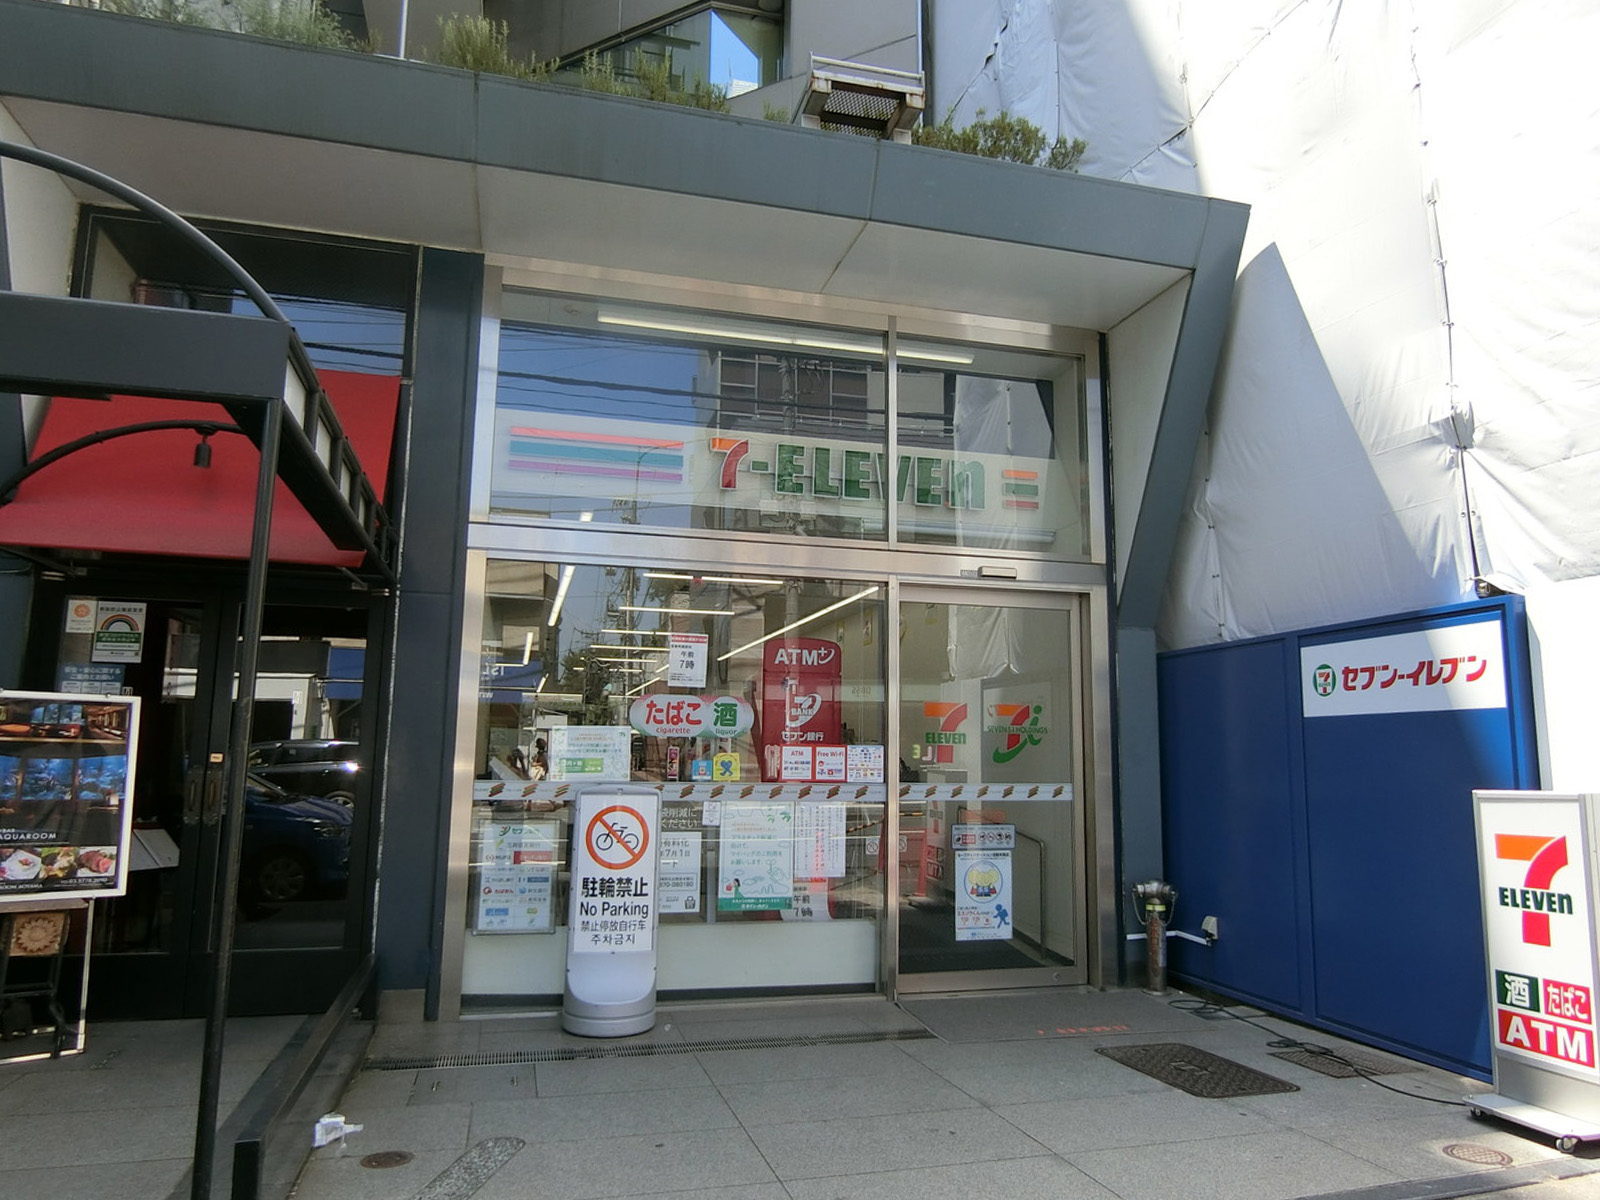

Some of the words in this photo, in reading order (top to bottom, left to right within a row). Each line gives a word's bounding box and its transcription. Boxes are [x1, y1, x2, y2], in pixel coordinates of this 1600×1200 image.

[645, 700, 703, 726] たばこ
[713, 702, 738, 727] 酒
[791, 707, 815, 717] BANK
[656, 727, 691, 735] cigarette
[715, 728, 738, 736] liquor
[781, 731, 824, 742] セブン銀行
[581, 877, 649, 898] 駐輪禁止
[580, 901, 598, 916] No
[602, 901, 649, 919] Parking
[581, 920, 647, 932] 禁止停放自行车
[591, 933, 636, 945] 주차금지
[1505, 974, 1531, 1006] 酒
[1547, 982, 1589, 1020] たばこ
[1506, 1015, 1589, 1063] ATM
